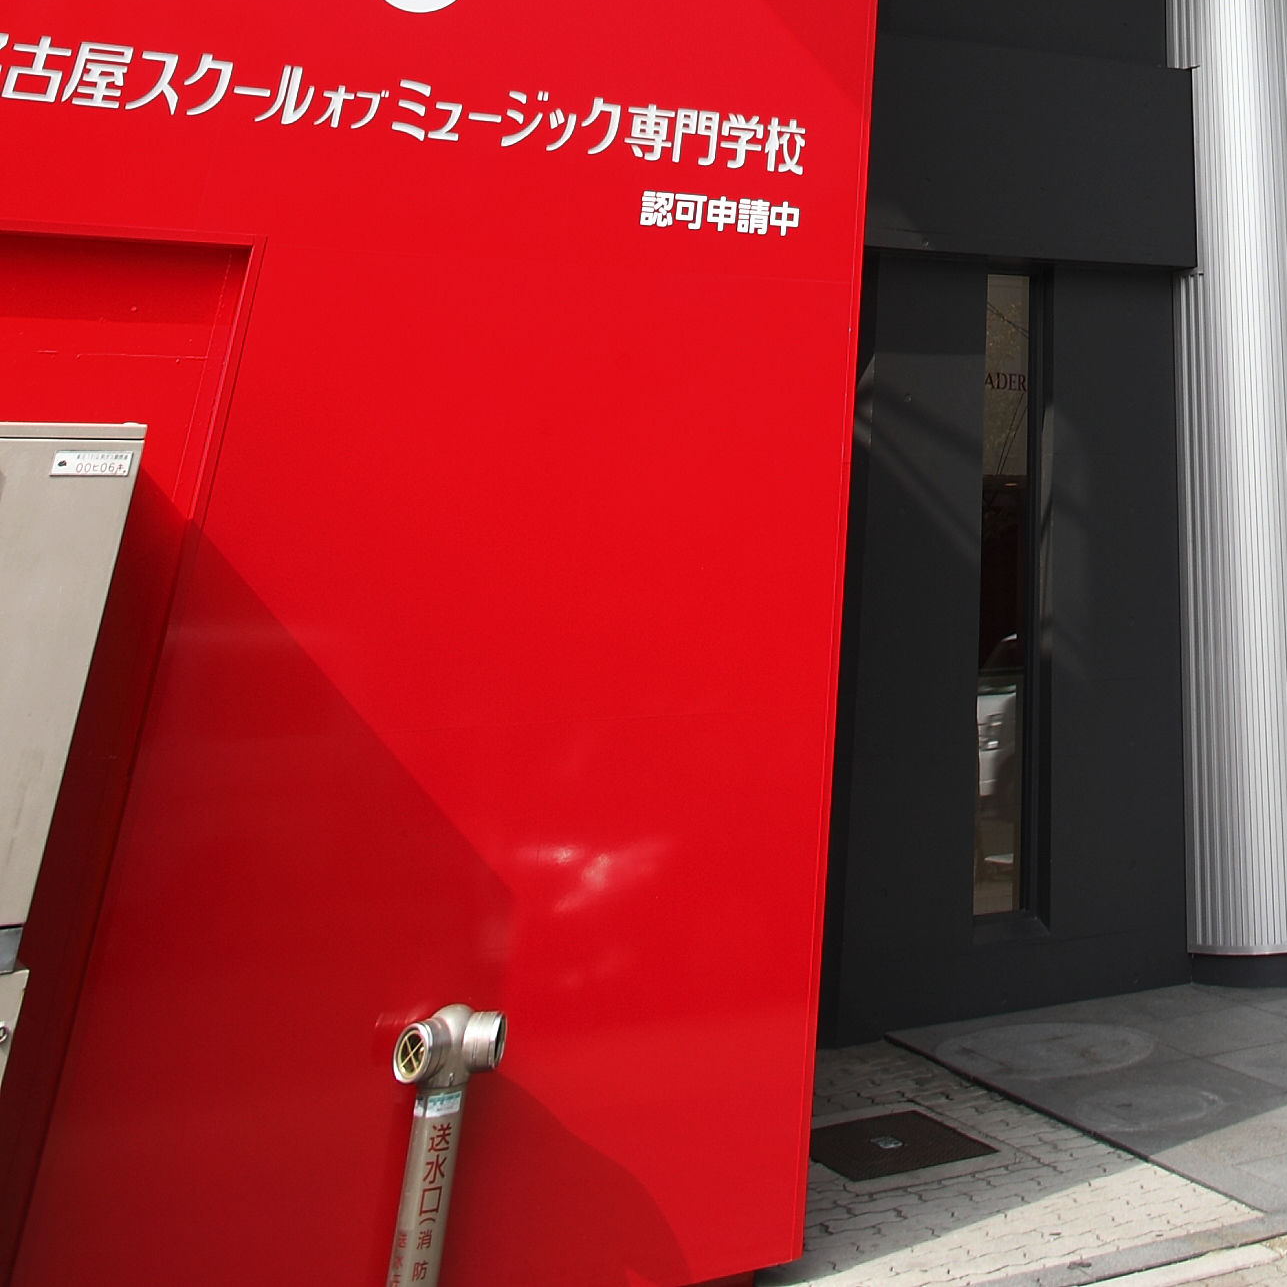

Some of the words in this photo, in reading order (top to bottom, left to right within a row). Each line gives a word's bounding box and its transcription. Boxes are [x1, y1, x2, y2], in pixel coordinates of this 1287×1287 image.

[0, 32, 806, 176] 古屋スクールオブミュージック専門学校
[639, 190, 800, 237] 認可申請中
